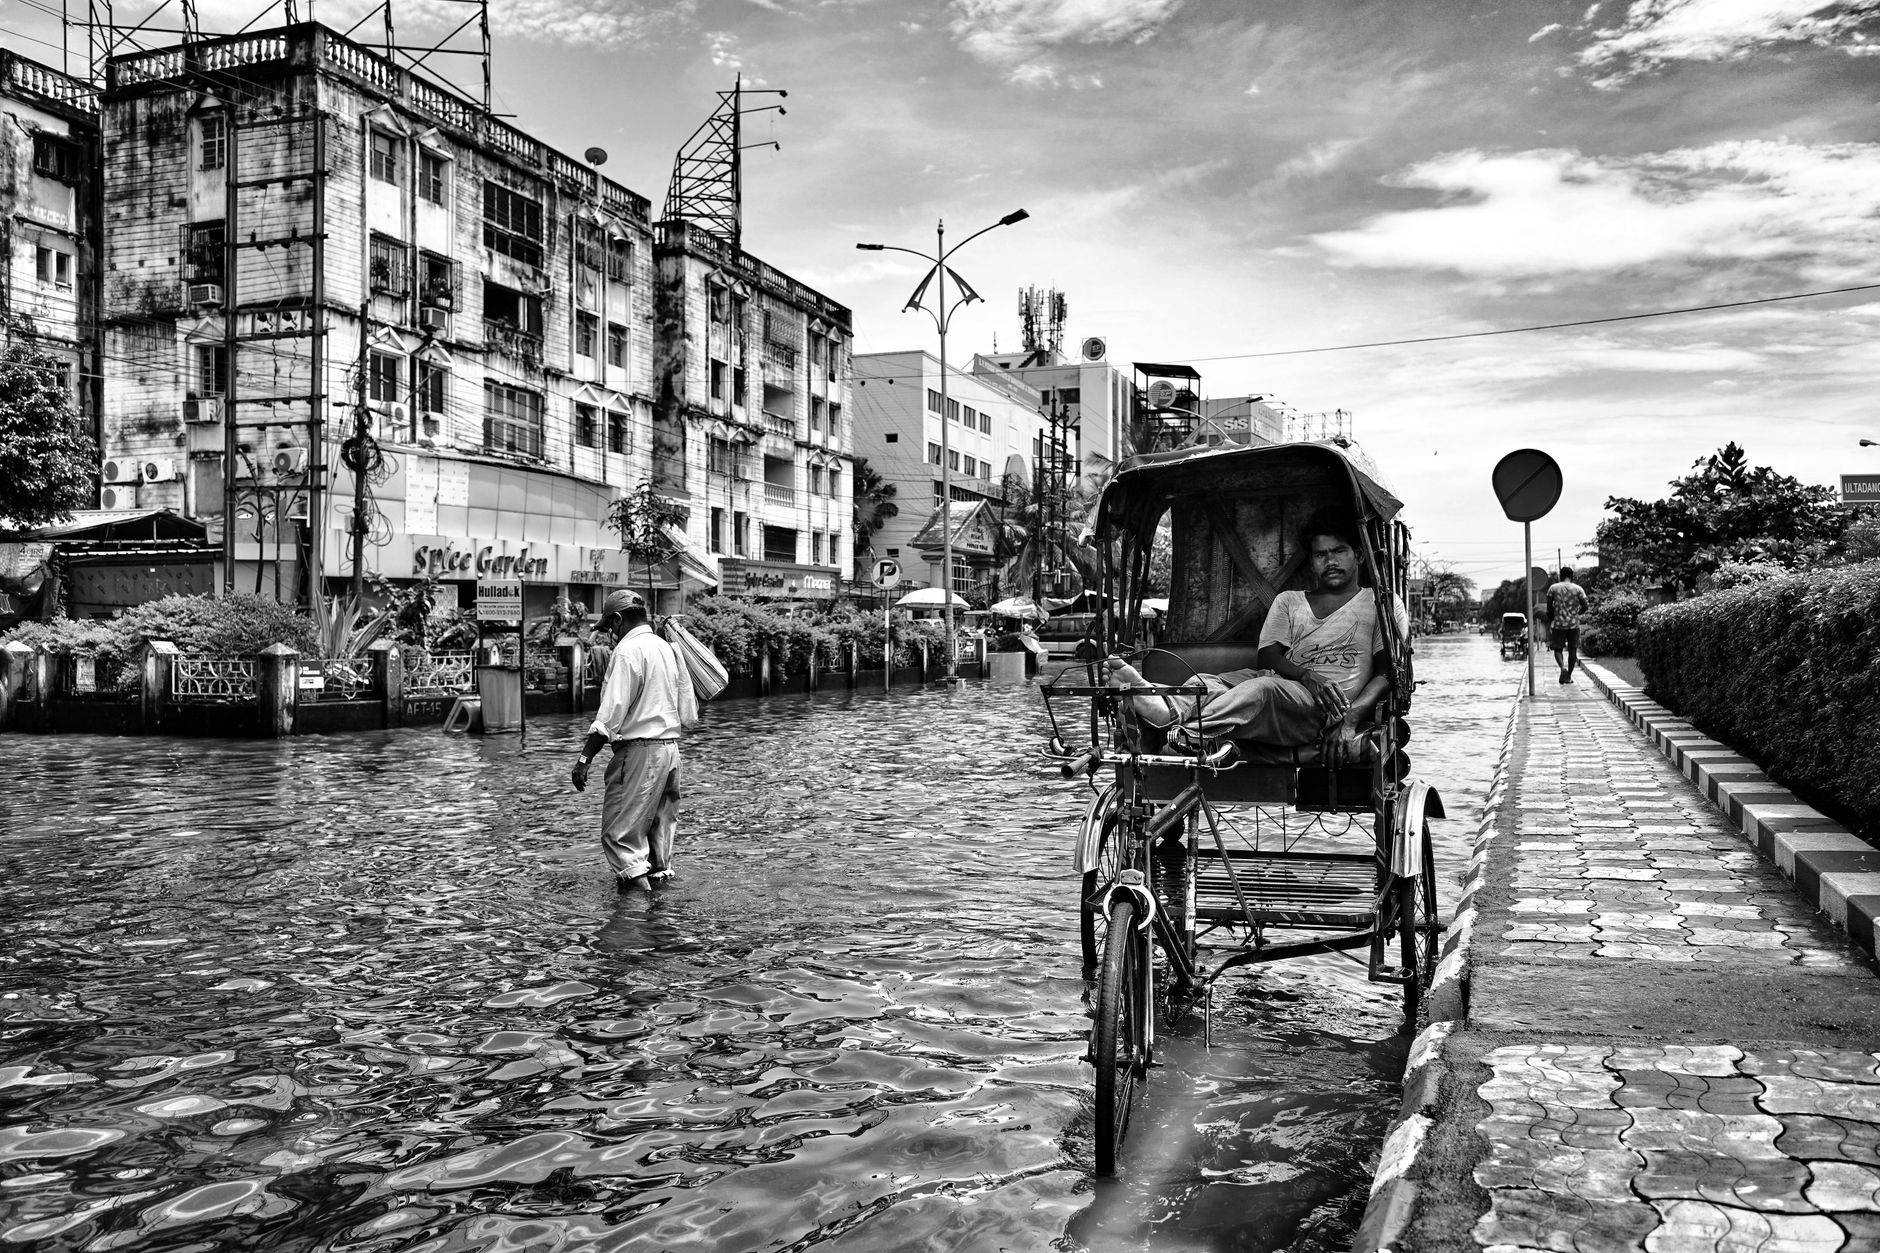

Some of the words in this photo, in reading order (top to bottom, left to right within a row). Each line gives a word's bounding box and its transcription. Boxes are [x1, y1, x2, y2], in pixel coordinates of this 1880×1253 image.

[412, 541, 472, 575] Spice
[476, 546, 548, 576] Garden
[478, 585, 520, 598] Hulladek
